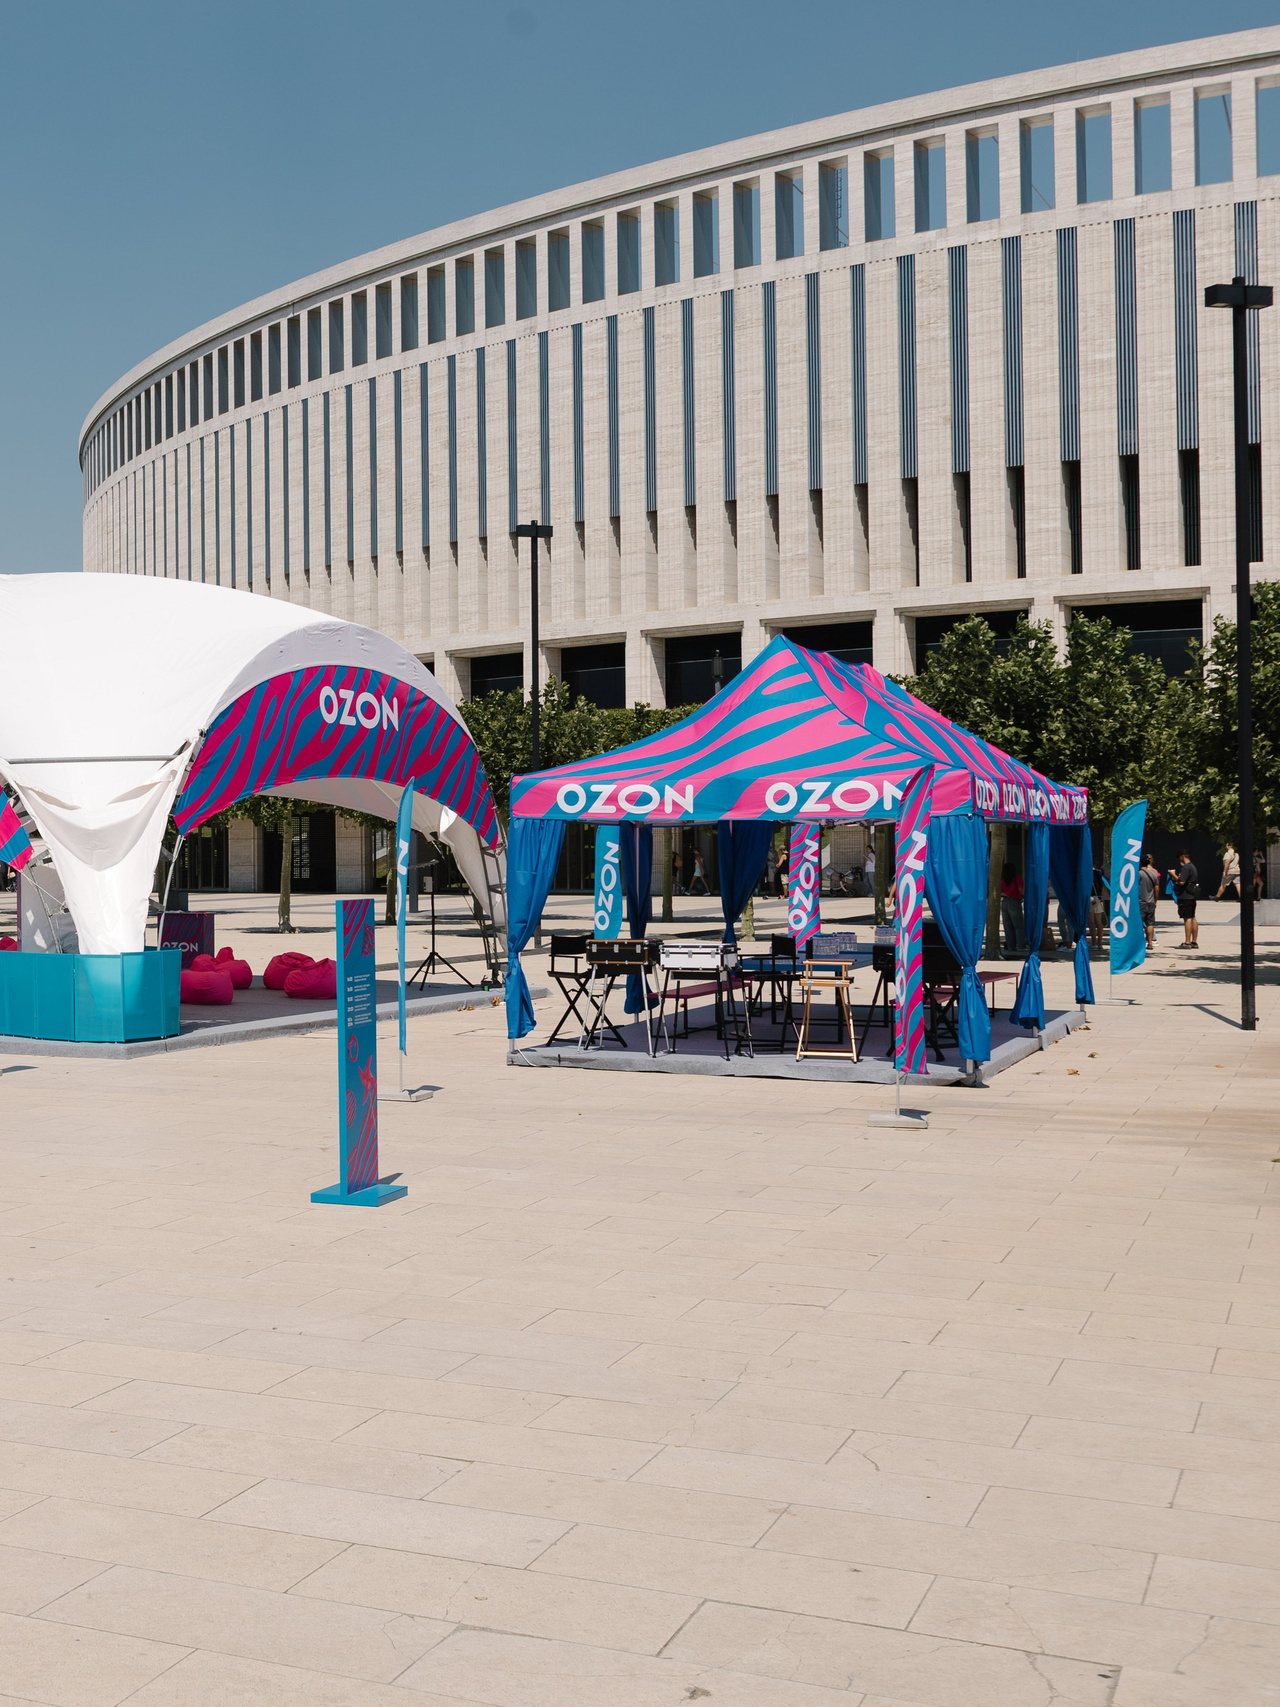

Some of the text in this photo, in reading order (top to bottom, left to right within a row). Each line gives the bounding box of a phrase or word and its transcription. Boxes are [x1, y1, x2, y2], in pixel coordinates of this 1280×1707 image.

[319, 685, 399, 732] OZON
[556, 783, 694, 814] OZON
[975, 777, 1000, 811] OZON
[1002, 782, 1027, 814] OZON
[594, 841, 619, 931] OZON
[788, 839, 819, 930] OZON
[1110, 838, 1142, 938] OZON
